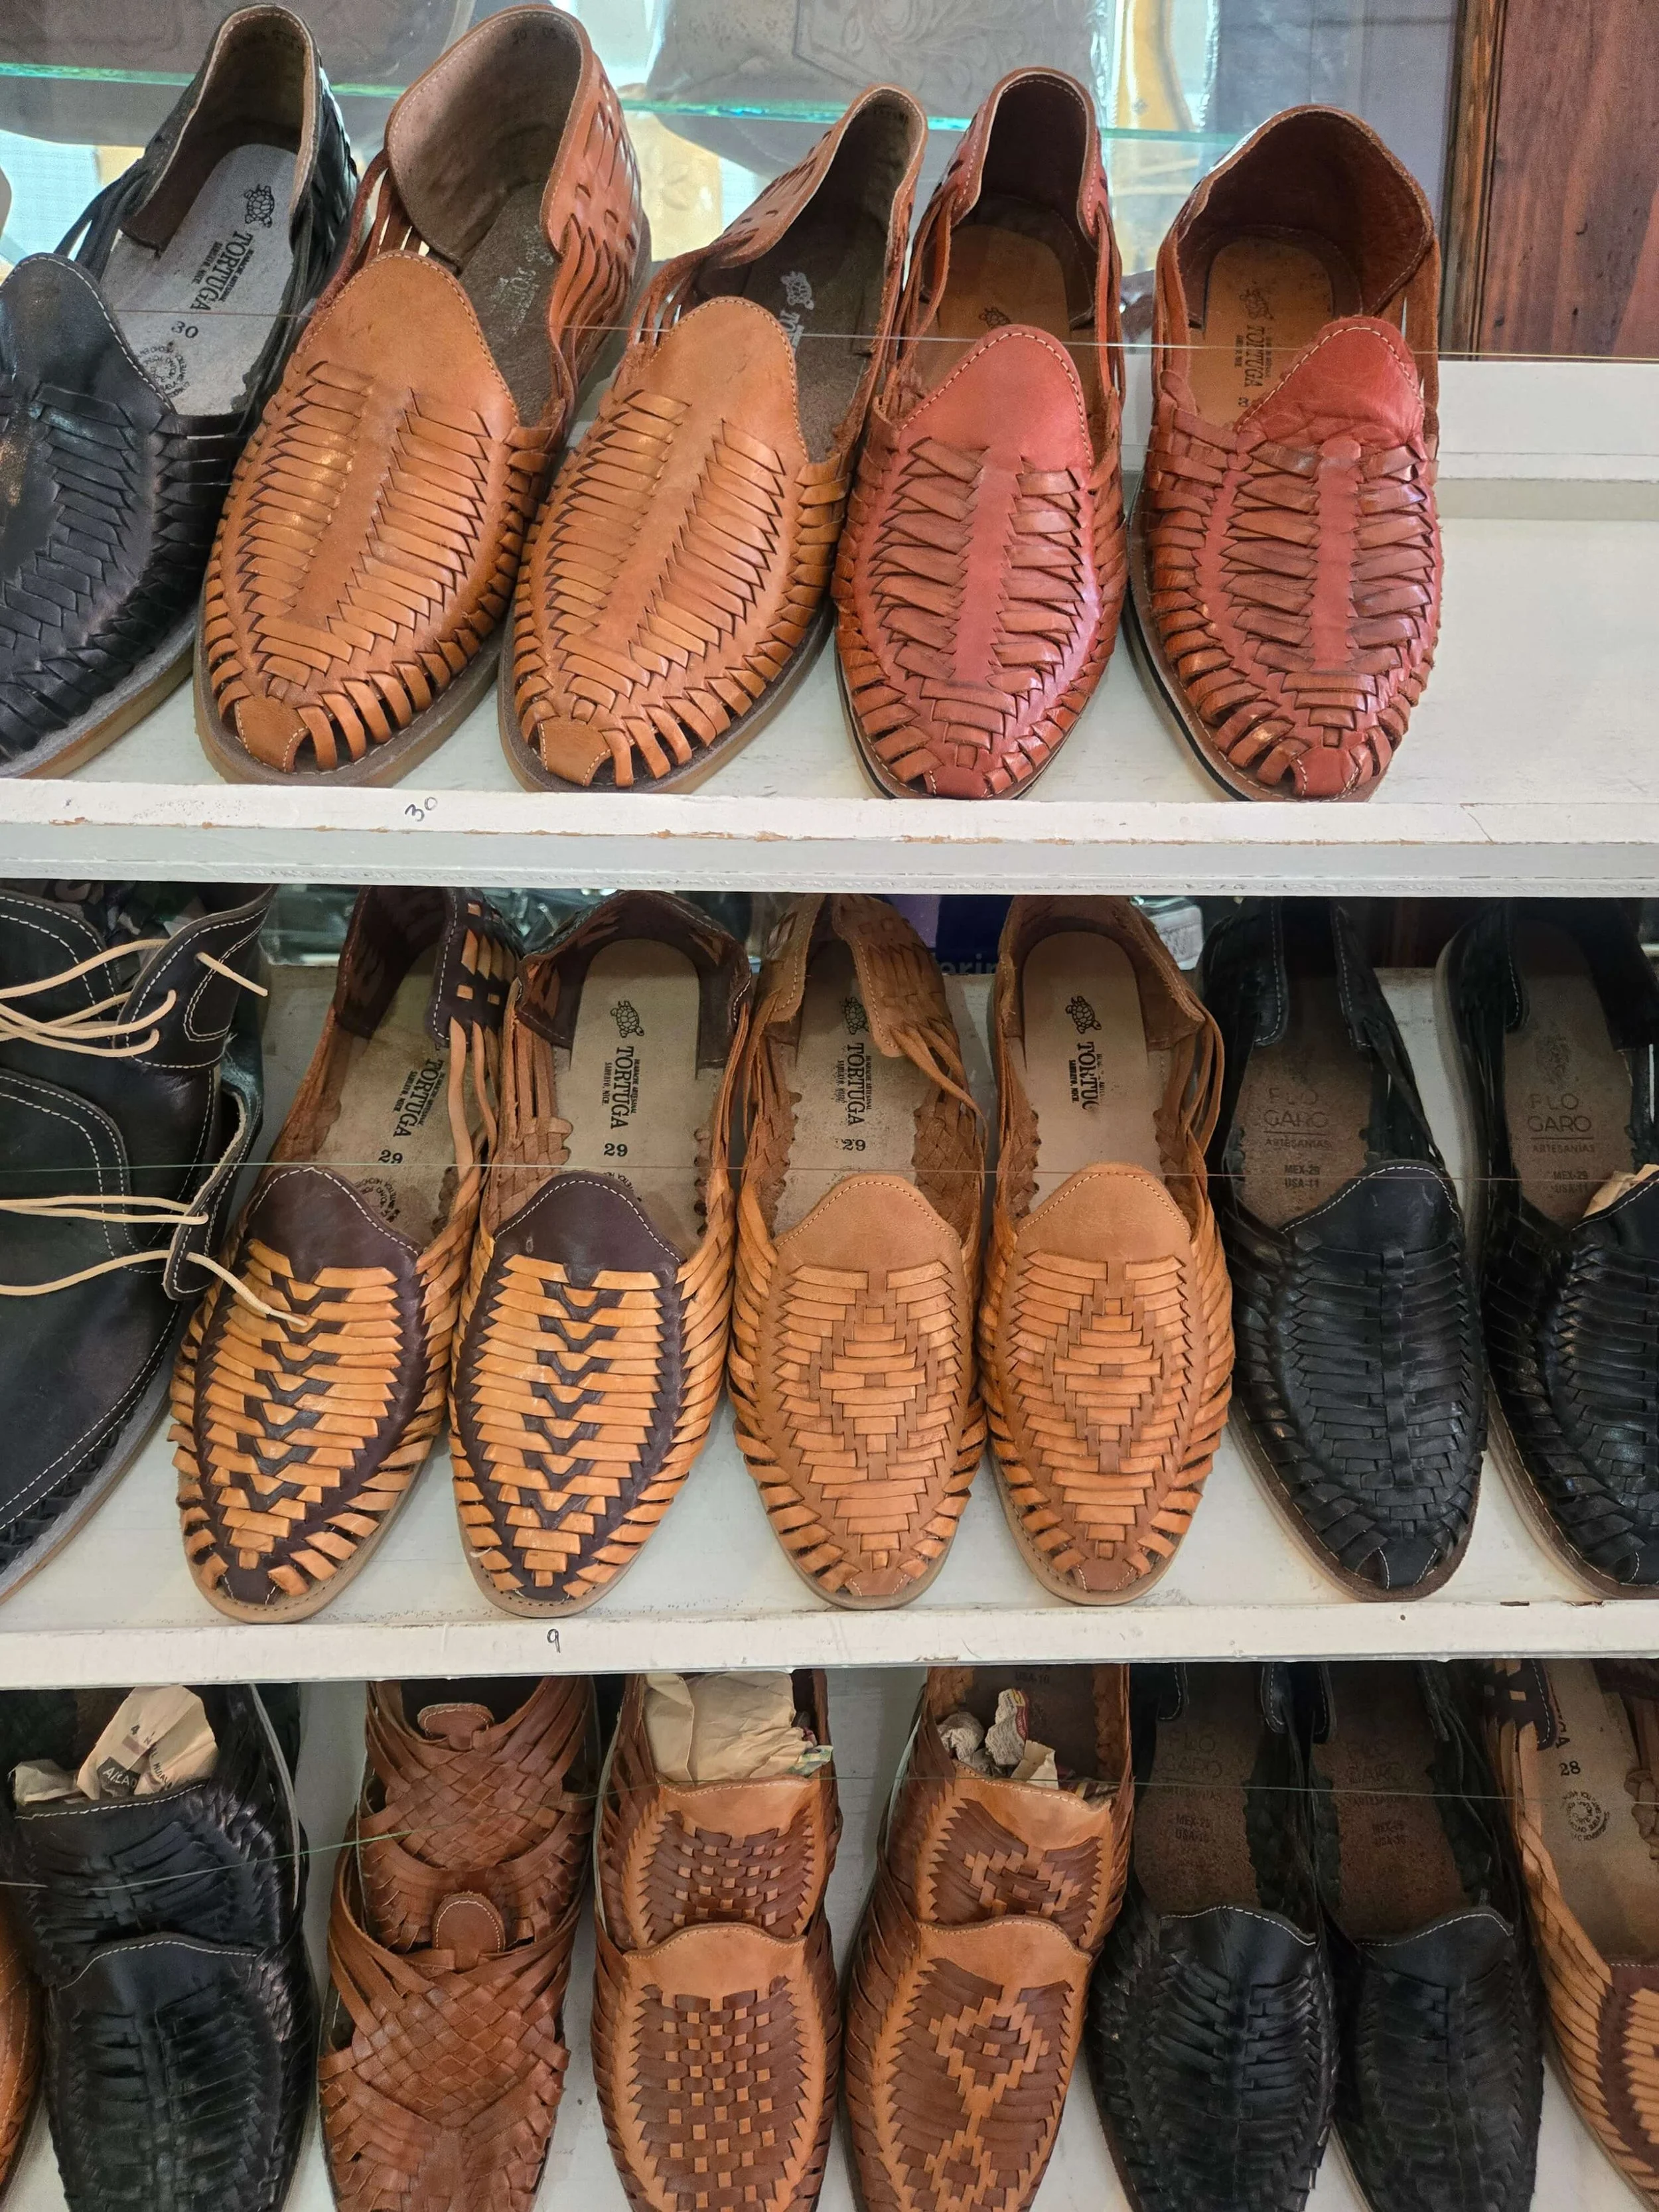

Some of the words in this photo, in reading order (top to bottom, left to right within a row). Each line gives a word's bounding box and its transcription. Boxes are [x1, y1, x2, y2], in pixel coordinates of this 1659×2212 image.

[190, 231, 253, 311] TORTUGA
[171, 321, 198, 338] 30
[405, 796, 438, 822] 30
[611, 1045, 634, 1130] TORTUGA
[846, 1042, 865, 1126] TORTUGA
[393, 1058, 444, 1138] TORTUGA
[1528, 1093, 1579, 1110] FLO
[1263, 1109, 1328, 1128] GARO
[1528, 1115, 1592, 1132] GARO
[603, 1143, 628, 1157] 29
[841, 1138, 866, 1151] 29
[378, 1149, 403, 1163] 29
[547, 1629, 561, 1653] 9
[1559, 1760, 1581, 1776] 28
